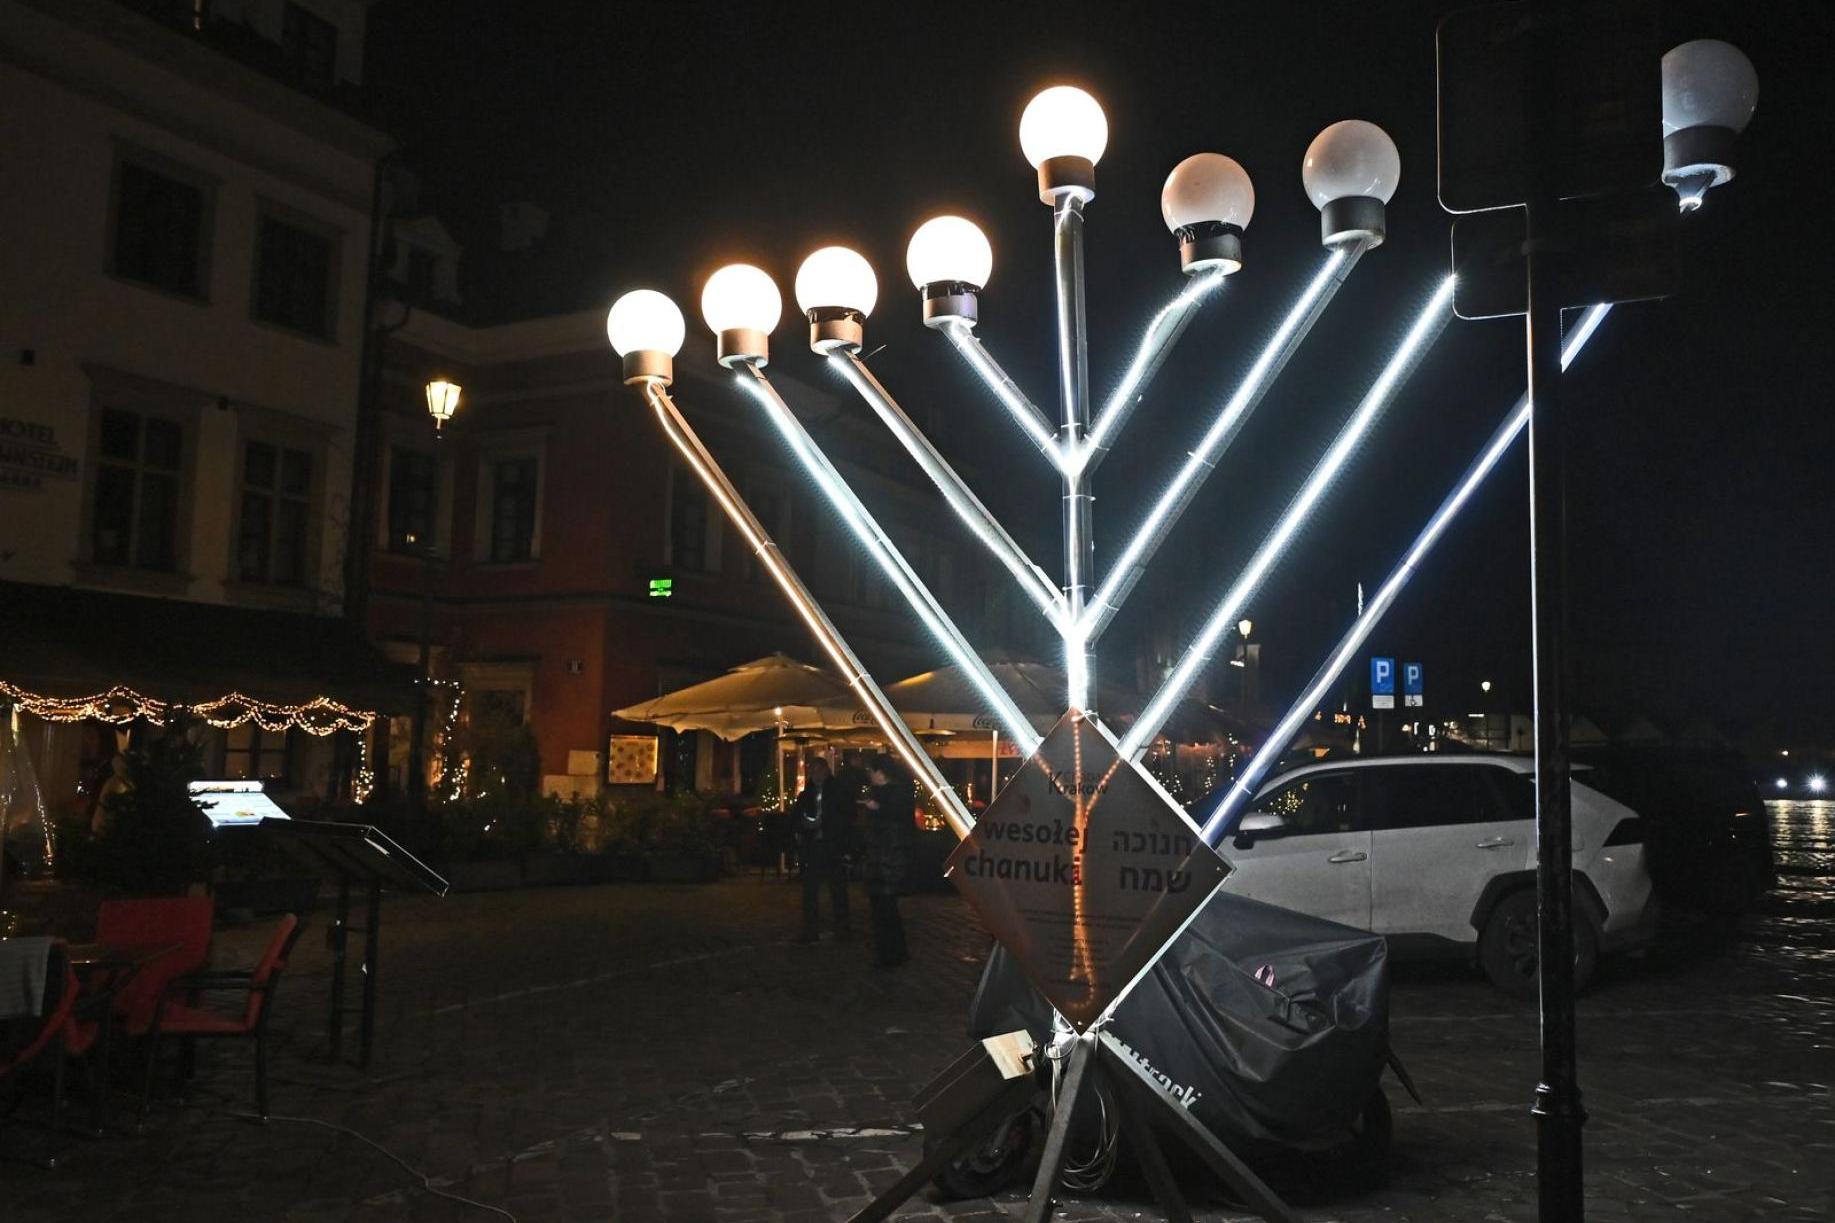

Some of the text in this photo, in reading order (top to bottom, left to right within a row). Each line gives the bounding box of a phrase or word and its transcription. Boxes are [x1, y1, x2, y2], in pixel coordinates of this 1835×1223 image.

[1376, 660, 1389, 684] P
[1407, 665, 1419, 686] P
[1113, 830, 1192, 856] חנוכה
[1119, 865, 1193, 893] שמח
